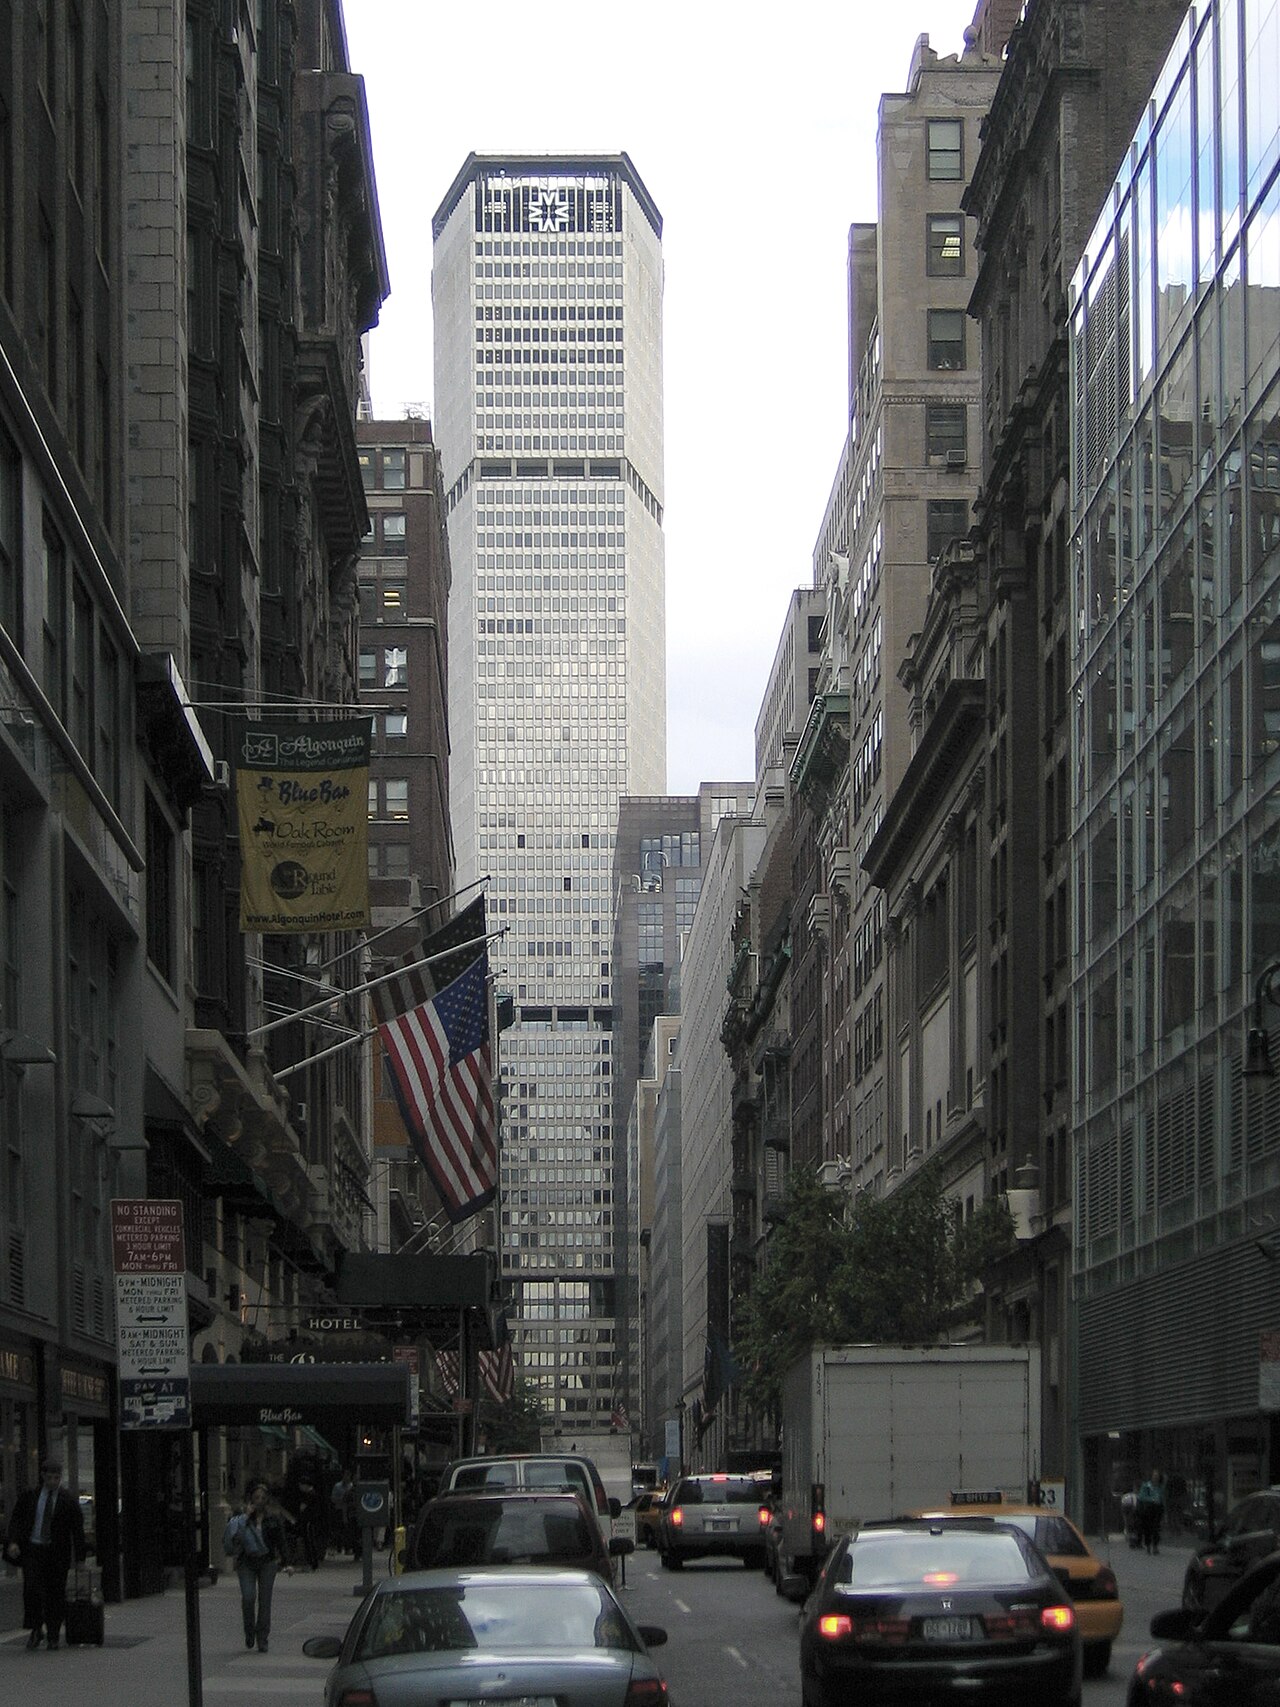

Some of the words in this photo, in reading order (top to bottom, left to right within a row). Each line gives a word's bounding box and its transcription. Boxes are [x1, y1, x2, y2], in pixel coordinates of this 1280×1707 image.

[279, 734, 364, 759] Algonquin
[276, 821, 309, 839] Oak
[312, 820, 354, 839] Room
[292, 867, 336, 888] Round
[310, 882, 336, 895] Table
[246, 909, 364, 925] www.AlgonquinHotel.com
[117, 1205, 130, 1216] NO
[133, 1204, 177, 1217] STANDING
[134, 1216, 160, 1225] EXCEPT
[115, 1225, 152, 1233] COMMERCIAL
[154, 1225, 181, 1234] VEHICLES
[116, 1234, 149, 1242] METERED
[150, 1233, 180, 1242] PARKING
[122, 1262, 142, 1270] MON
[163, 1262, 178, 1270] FRI
[123, 1288, 143, 1296] MON
[164, 1288, 179, 1296] FRI
[120, 1296, 152, 1305] METERED
[153, 1296, 183, 1305] PARKING
[135, 1305, 155, 1313] HOUR
[156, 1305, 174, 1313] LIMIT
[310, 1318, 362, 1330] HOTEL
[129, 1340, 146, 1348] SAT
[159, 1340, 178, 1348] SUN
[122, 1348, 154, 1356] METERED
[155, 1348, 185, 1356] PARKING
[137, 1357, 156, 1365] HOUR
[159, 1357, 177, 1365] LIMIT
[269, 1353, 284, 1362] THE
[134, 1382, 156, 1393] PAY
[161, 1382, 175, 1392] AT
